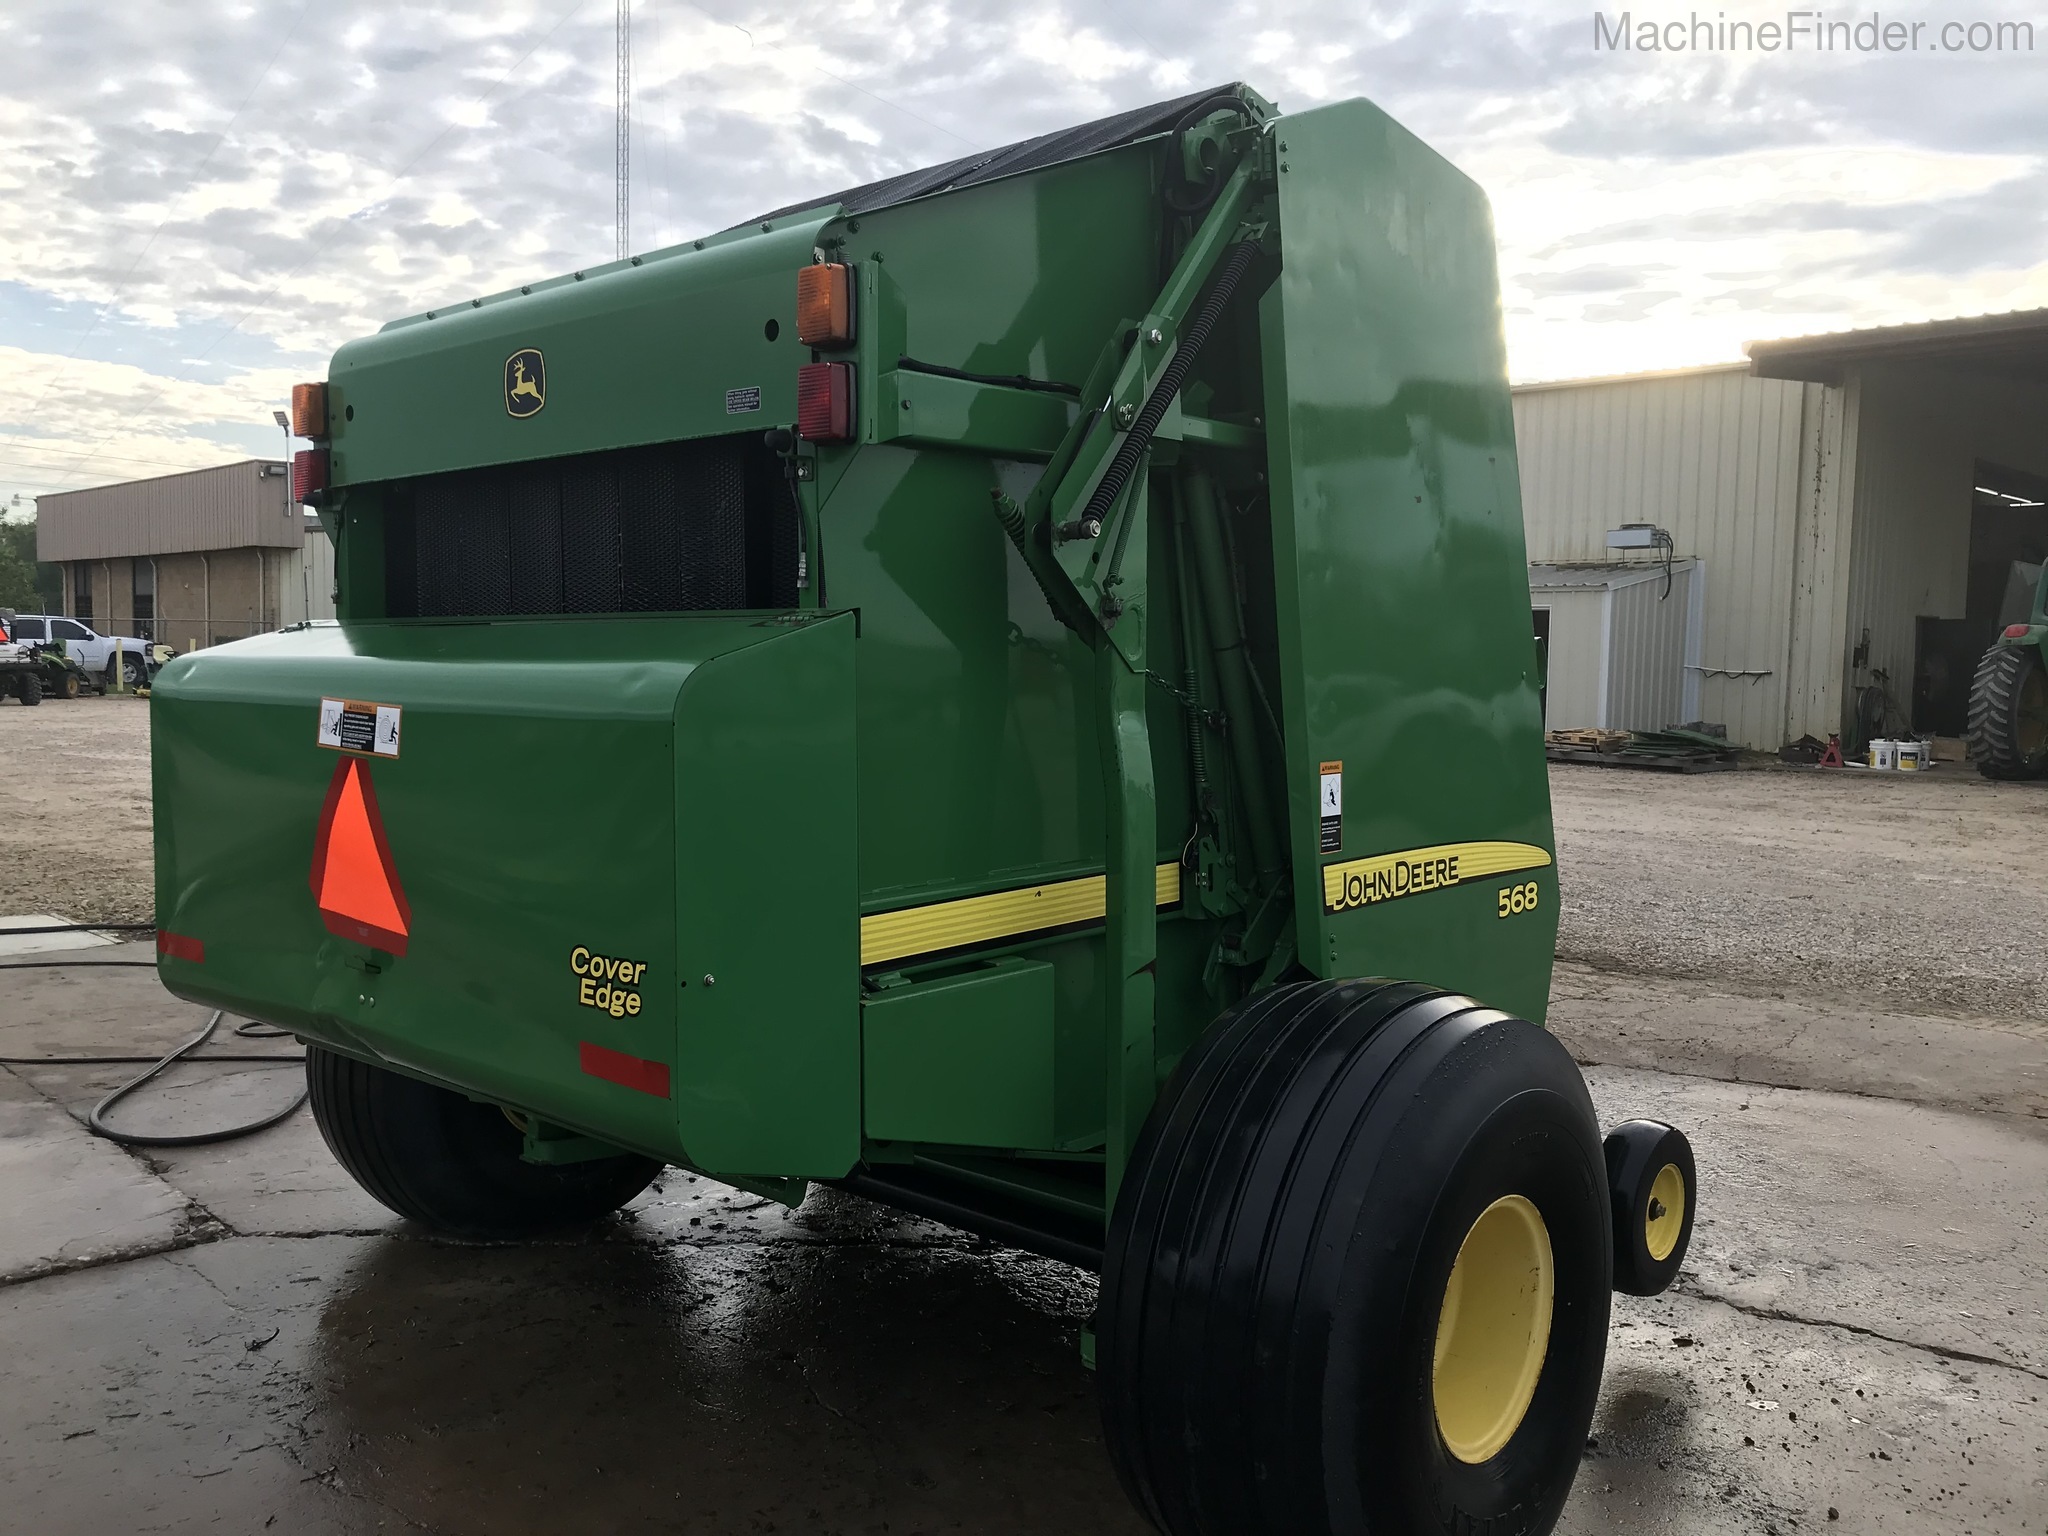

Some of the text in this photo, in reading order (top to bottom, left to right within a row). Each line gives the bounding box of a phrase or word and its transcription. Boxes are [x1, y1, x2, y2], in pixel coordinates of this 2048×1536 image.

[1334, 856, 1460, 909] JOHN DEERE
[1499, 881, 1538, 918] 568
[571, 946, 646, 984] Cover
[579, 977, 642, 1018] Edge
